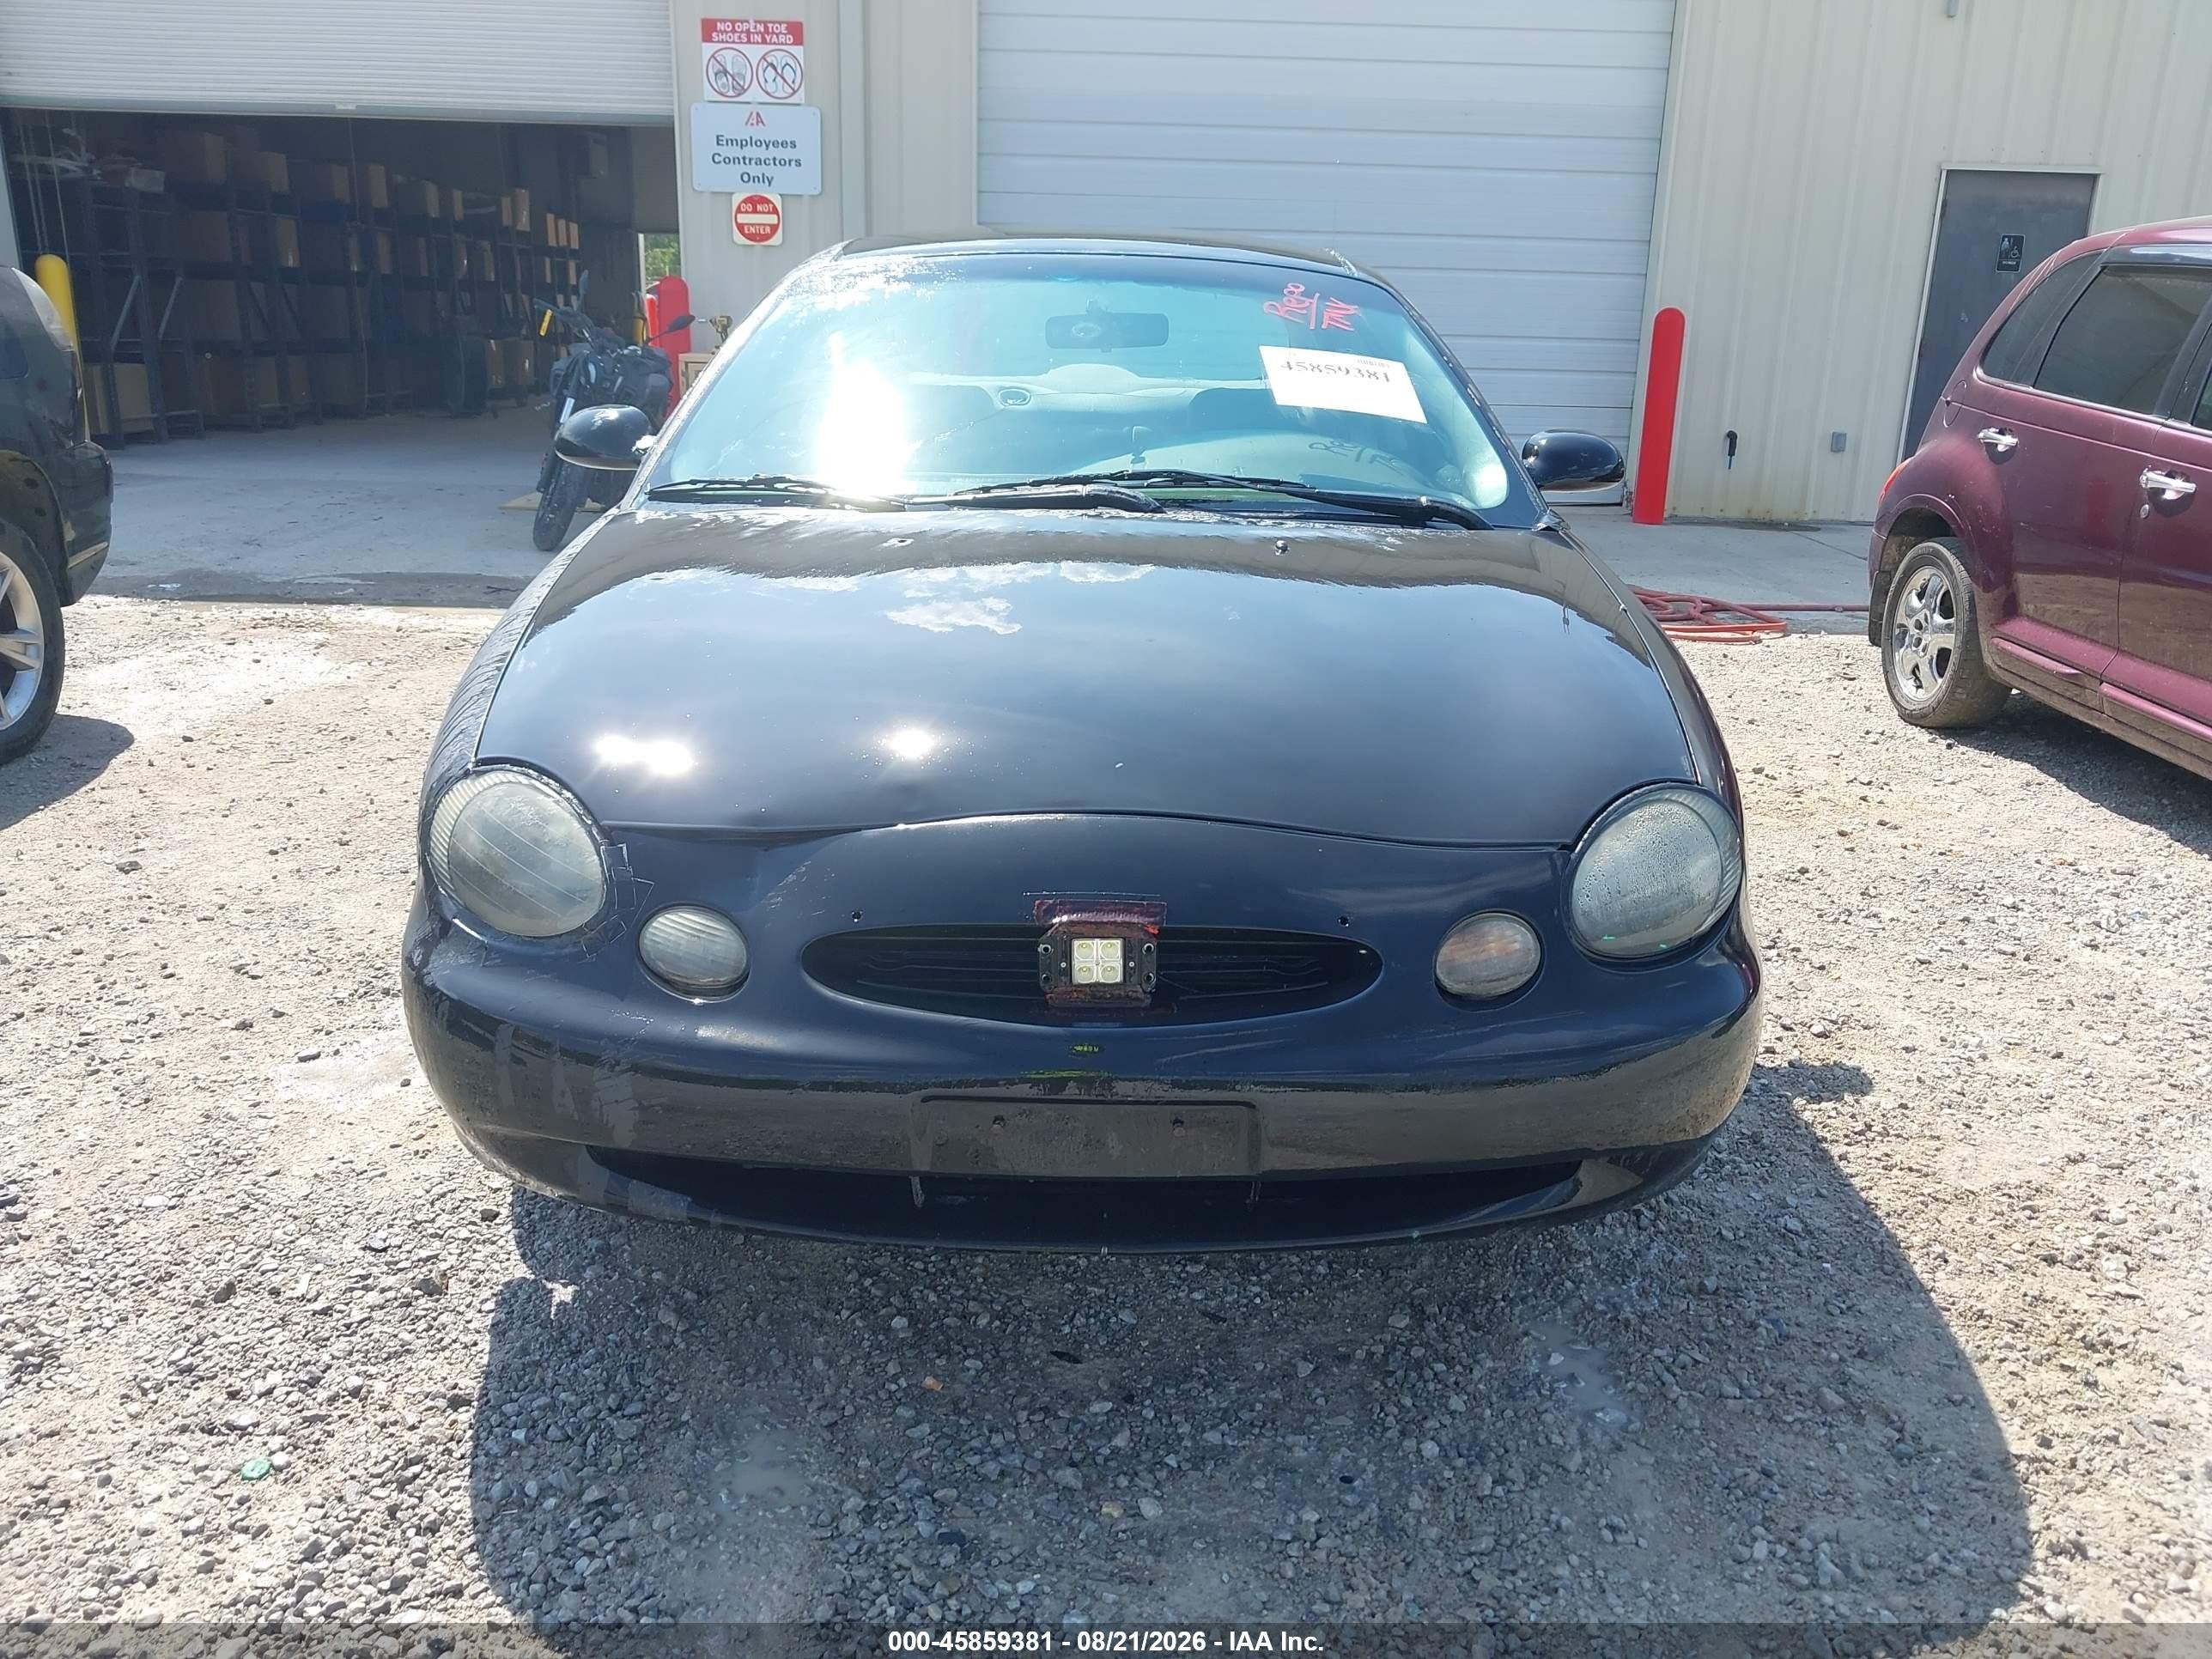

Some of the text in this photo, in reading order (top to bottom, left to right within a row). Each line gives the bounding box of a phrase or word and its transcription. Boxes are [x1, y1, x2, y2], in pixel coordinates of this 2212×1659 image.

[716, 21, 788, 33] NO OPEN TOE
[712, 33, 794, 44] SHOES IN YARD
[715, 135, 797, 150] Employees
[711, 152, 802, 167] Contractors
[739, 171, 775, 187] Only
[740, 203, 774, 213] DO NOT
[744, 225, 771, 234] ENTER
